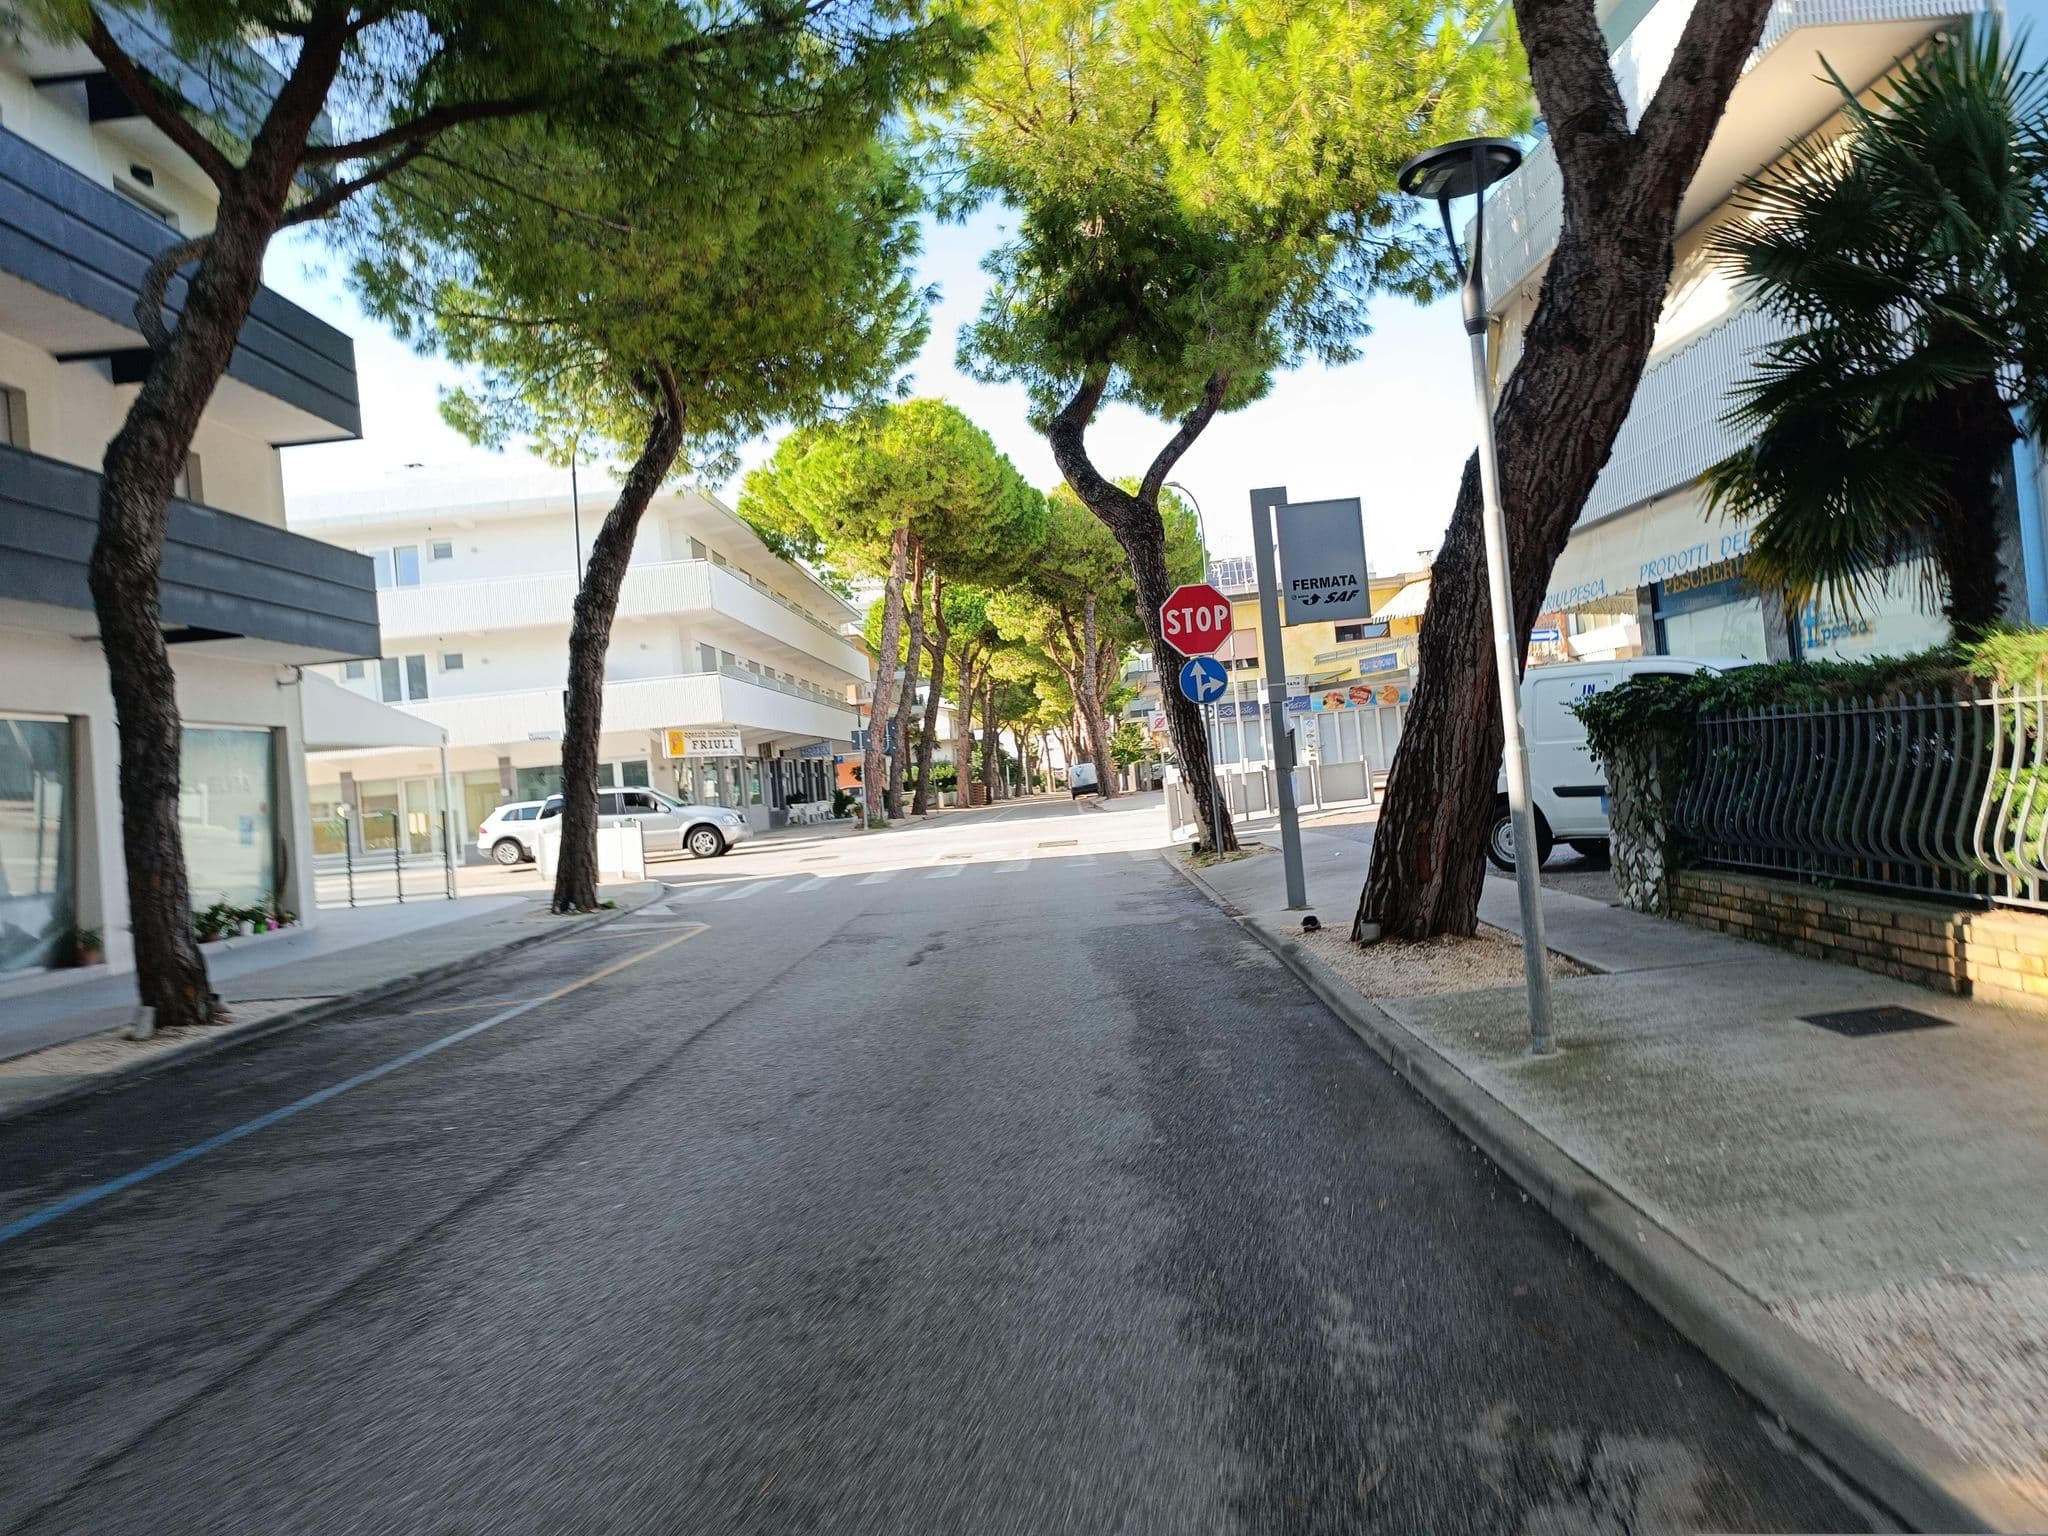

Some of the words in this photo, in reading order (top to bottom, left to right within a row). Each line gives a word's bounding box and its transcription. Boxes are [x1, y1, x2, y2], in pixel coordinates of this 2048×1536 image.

[1640, 543, 1709, 582] PRODOTTI
[1292, 574, 1358, 591] FERMATA
[1324, 589, 1360, 604] SAF
[1541, 578, 1605, 610] RIULPESCA
[1166, 604, 1228, 635] STOP
[1583, 684, 1596, 695] IN
[691, 739, 734, 750] FRIULI
